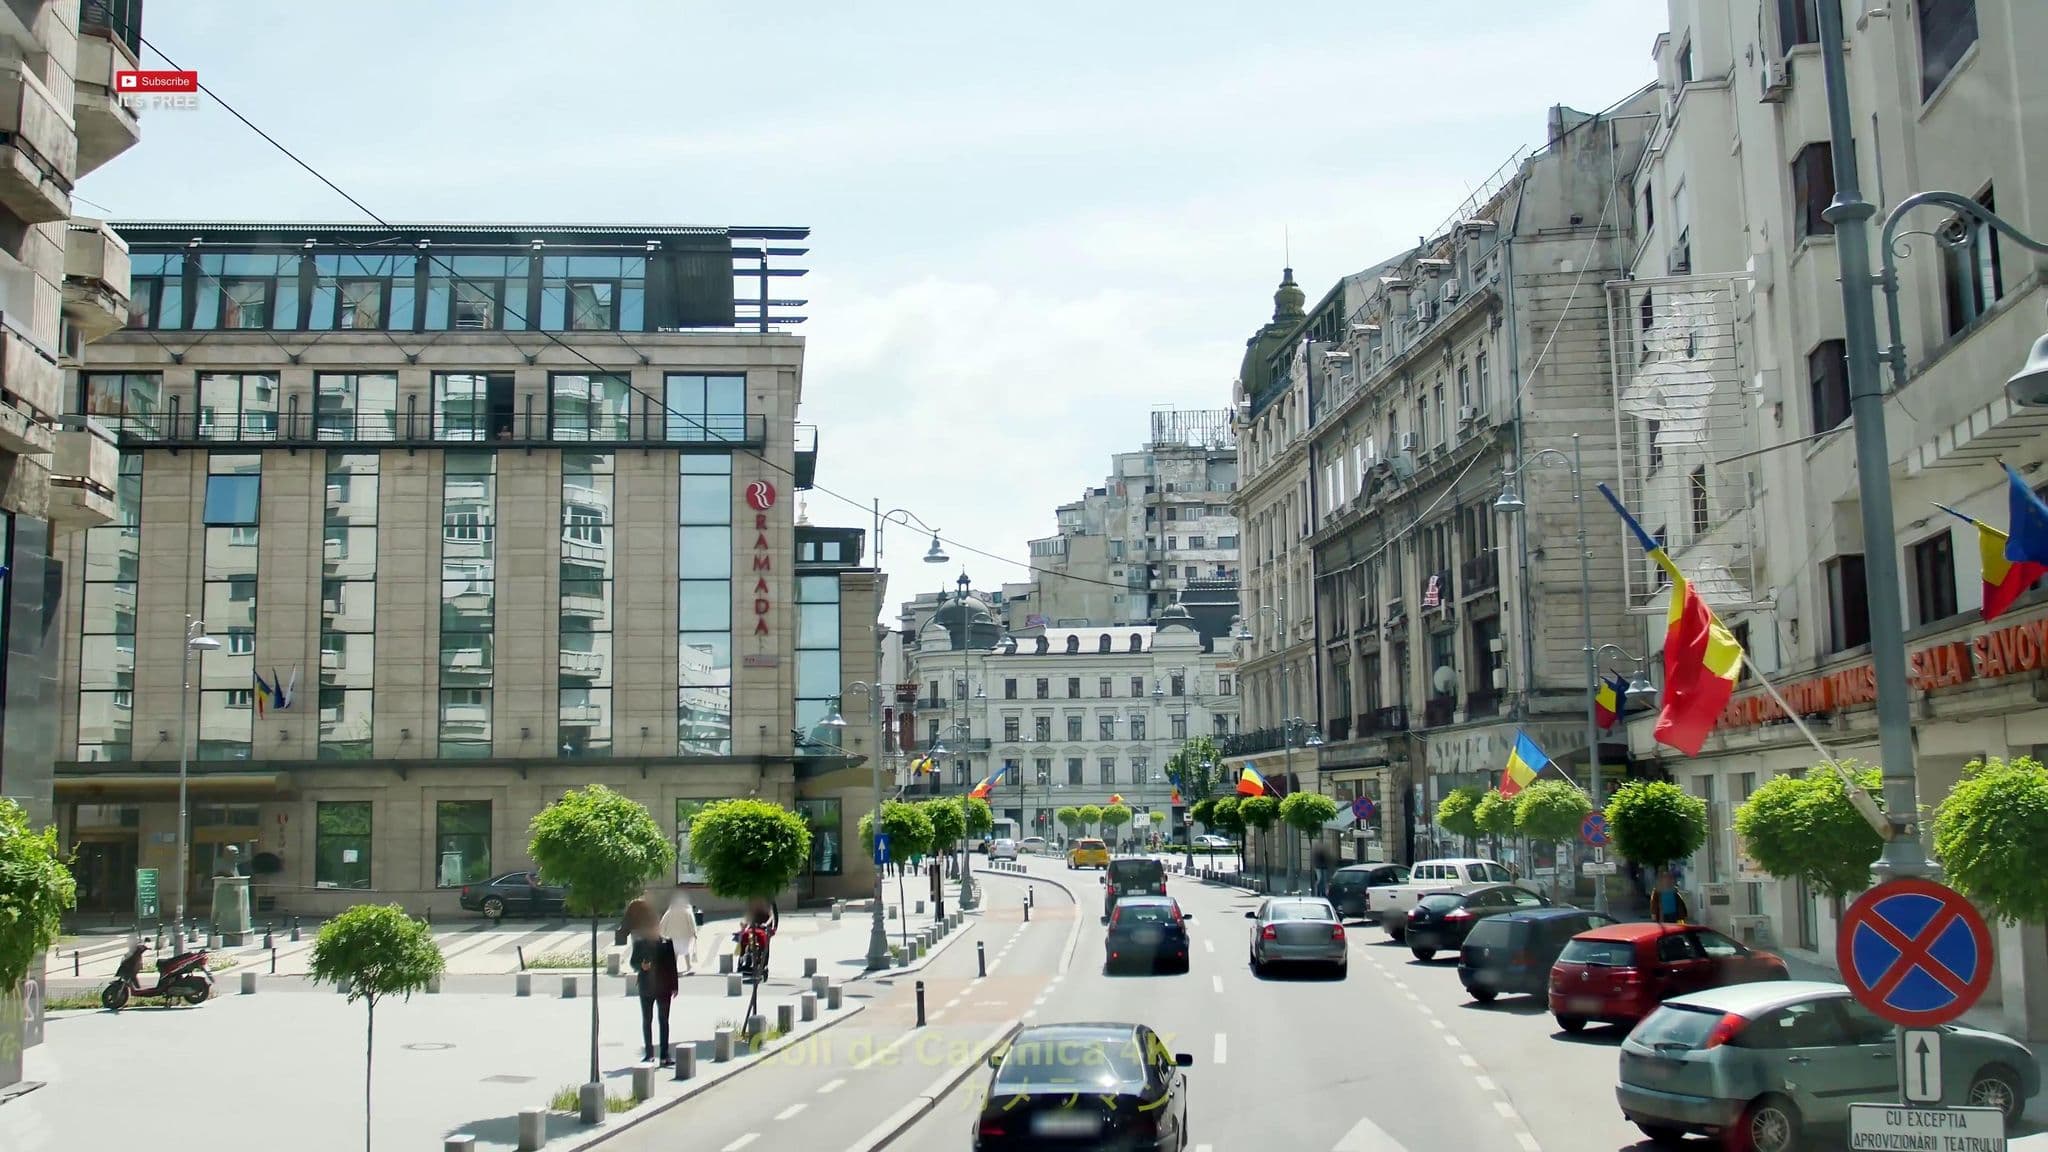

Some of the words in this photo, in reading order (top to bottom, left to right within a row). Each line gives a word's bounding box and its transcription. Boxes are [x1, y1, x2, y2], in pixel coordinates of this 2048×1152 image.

[753, 514, 770, 636] RAMADA
[1910, 640, 1971, 691] SALA
[1886, 1110, 1902, 1126] CU
[1943, 1136, 2003, 1152] TEATRULUI
